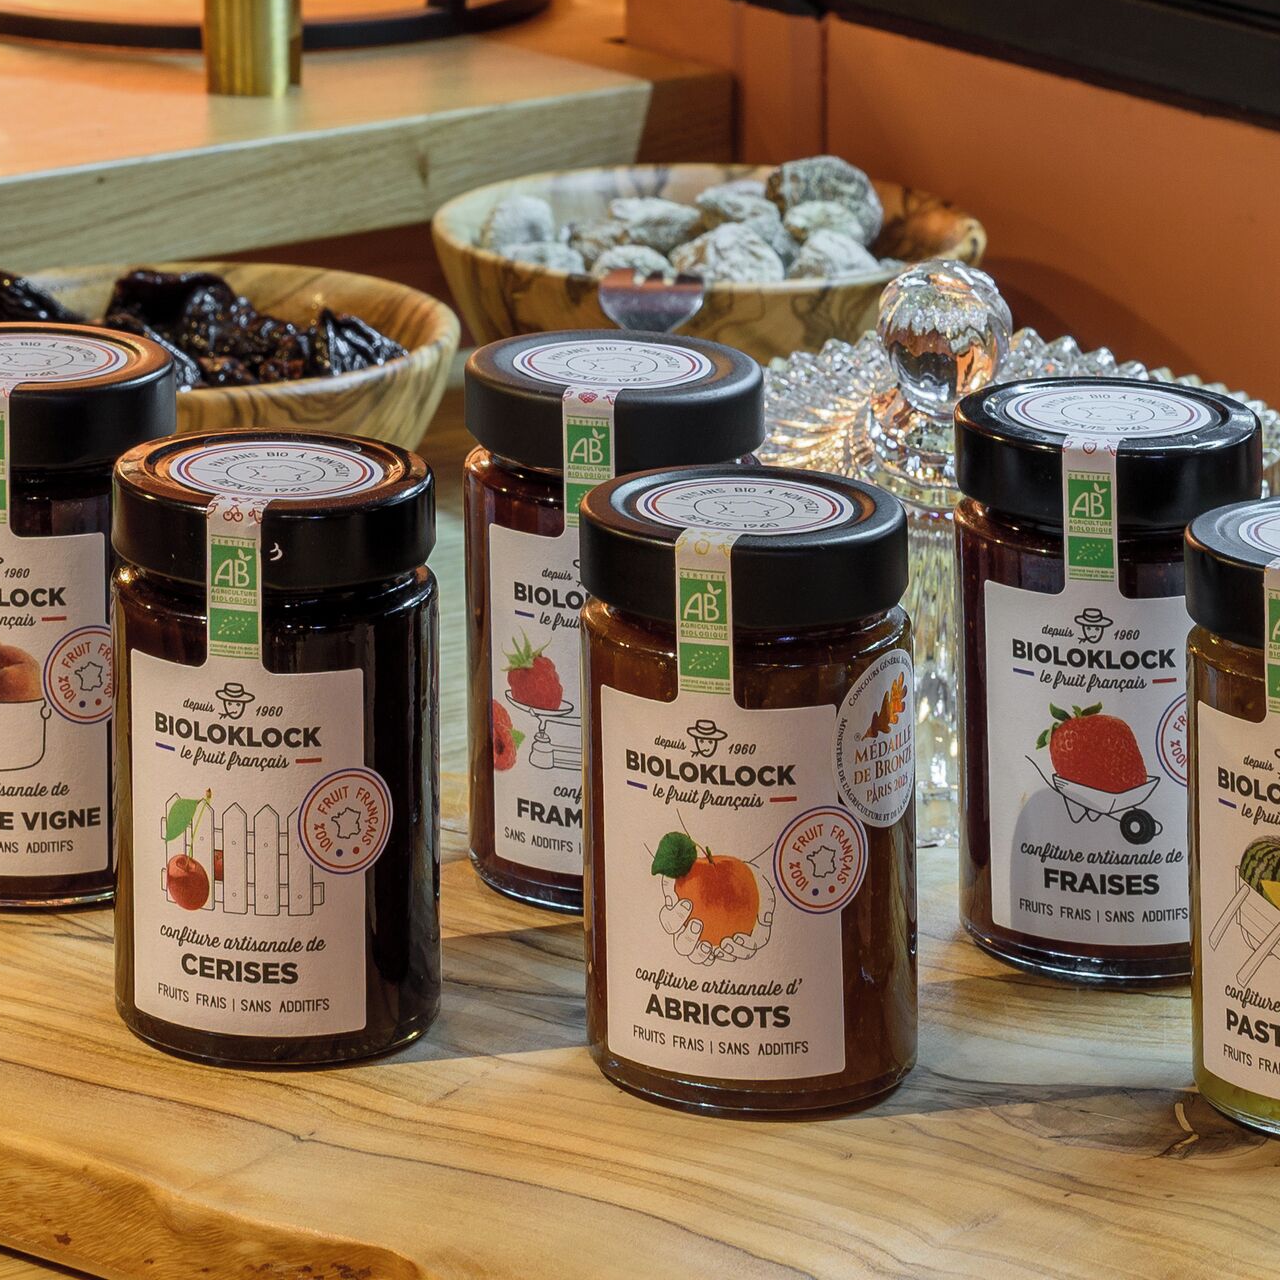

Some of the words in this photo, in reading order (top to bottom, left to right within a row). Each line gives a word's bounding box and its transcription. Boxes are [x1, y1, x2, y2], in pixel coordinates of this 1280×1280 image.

[4, 568, 30, 578] 1960
[215, 558, 250, 588] AB
[541, 568, 574, 581] depuis
[211, 588, 257, 598] AGRICULTURE
[211, 595, 257, 606] BIOLOGIQUE
[683, 592, 720, 621] AB
[1042, 624, 1074, 638] depuis
[1114, 629, 1140, 641] 1960
[61, 641, 92, 669] FRUIT
[1012, 638, 1176, 670] BIOLOKLOCK
[1040, 670, 1052, 684] le
[1052, 672, 1086, 690] fruit
[1086, 675, 1147, 693] français
[183, 698, 215, 713] depuis
[255, 705, 283, 717] 1960
[155, 711, 322, 748] BIOLOKLOCK
[654, 735, 687, 751] depuis
[728, 743, 756, 756] 1960
[854, 724, 911, 765] MÉDAILLE
[180, 745, 193, 760] le
[193, 747, 226, 766] fruit
[227, 751, 290, 771] français
[626, 749, 796, 787] BIOLOKLOCK
[1243, 755, 1274, 771] depuis
[51, 782, 70, 796] de
[854, 767, 871, 785] DE
[652, 783, 665, 799] le
[665, 785, 699, 805] fruit
[700, 791, 765, 811] français
[866, 780, 892, 805] PARIS
[21, 807, 102, 831] VIGNE
[317, 785, 350, 815] FRUIT
[356, 786, 379, 846] FRANÇAIS
[1241, 802, 1252, 818] le
[26, 839, 74, 854] ADDITIFS
[504, 827, 526, 844] SANS
[531, 835, 573, 853] ADDITIFS
[792, 823, 824, 853] FRUIT
[830, 824, 854, 885] FRANÇAIS
[1021, 842, 1084, 863] confiture
[1087, 850, 1163, 865] artisanale
[1165, 849, 1184, 863] de
[1044, 867, 1160, 896] FRAISES
[1020, 898, 1053, 916] FRUITS
[1060, 906, 1091, 921] FRAIS
[1105, 910, 1135, 923] SANS
[1142, 907, 1188, 922] ADDITIFS
[160, 924, 221, 948] confiture
[223, 937, 304, 953] artisanale
[305, 936, 327, 952] de
[181, 953, 299, 985] CERISES
[635, 967, 699, 991] confiture
[701, 979, 783, 996] artisanale
[158, 982, 190, 1003] FRUITS
[196, 993, 227, 1010] FRAIS
[240, 999, 272, 1013] SANS
[279, 998, 330, 1013] ADDITIFS
[645, 994, 791, 1029] ABRICOTS
[633, 1025, 666, 1045] FRUITS
[672, 1035, 704, 1052] FRAIS
[718, 1041, 750, 1056] SANS
[758, 1040, 809, 1056] ADDITIFS
[1223, 1044, 1252, 1067] FRUITS
